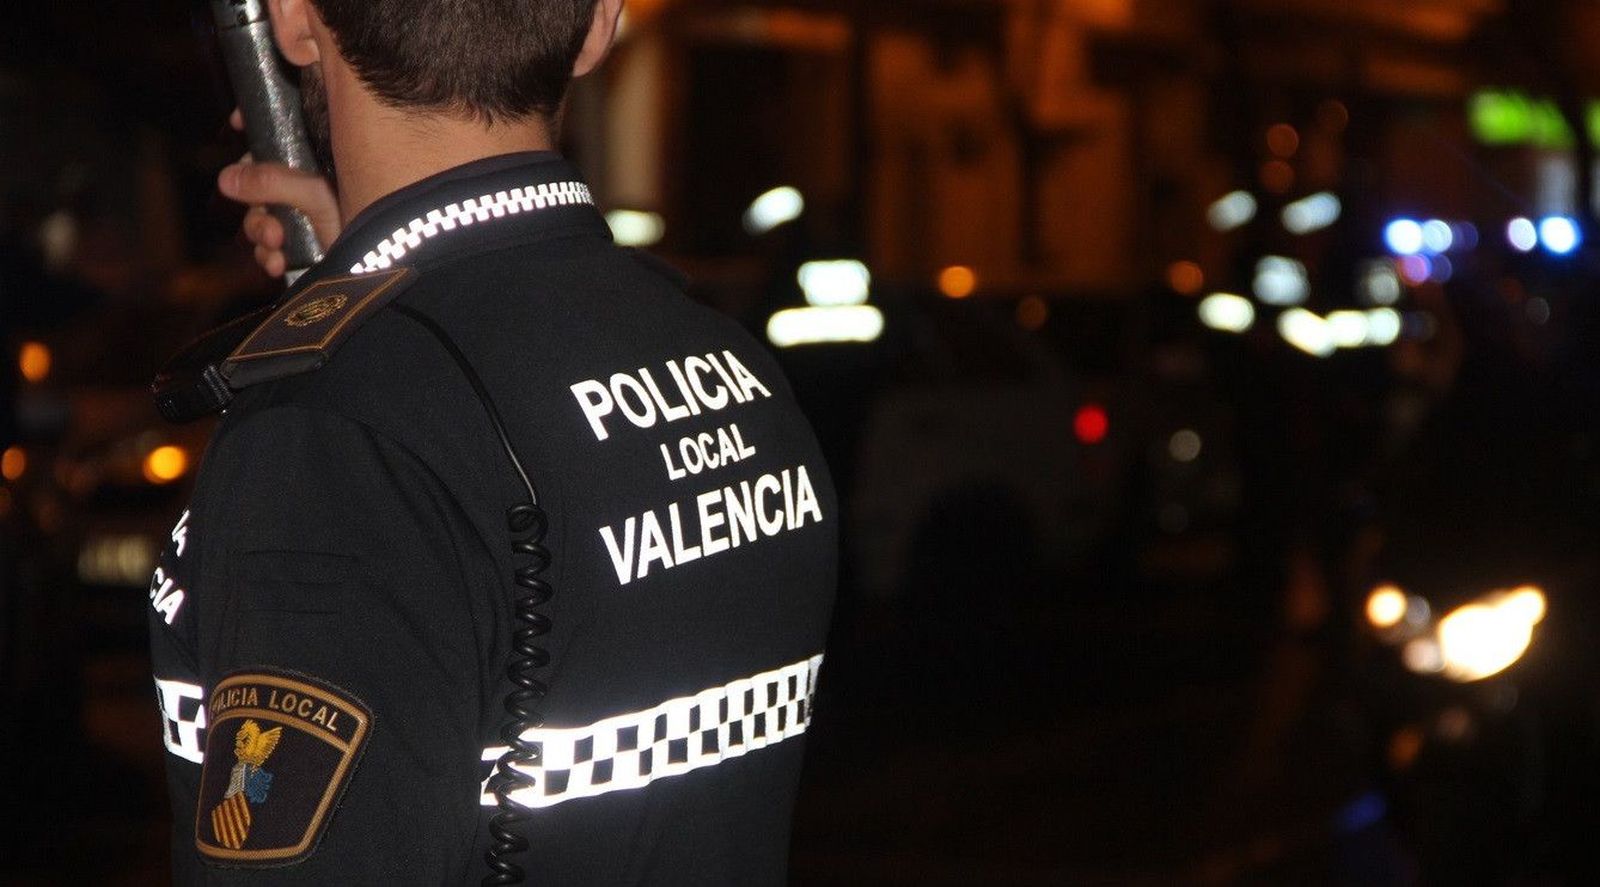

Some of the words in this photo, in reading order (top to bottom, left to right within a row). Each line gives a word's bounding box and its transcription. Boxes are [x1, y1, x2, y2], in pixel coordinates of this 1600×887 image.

[569, 350, 772, 441] POLICIA
[660, 423, 756, 481] LOCAL
[598, 465, 823, 585] VALENCIA
[268, 689, 338, 731] LOCAL
